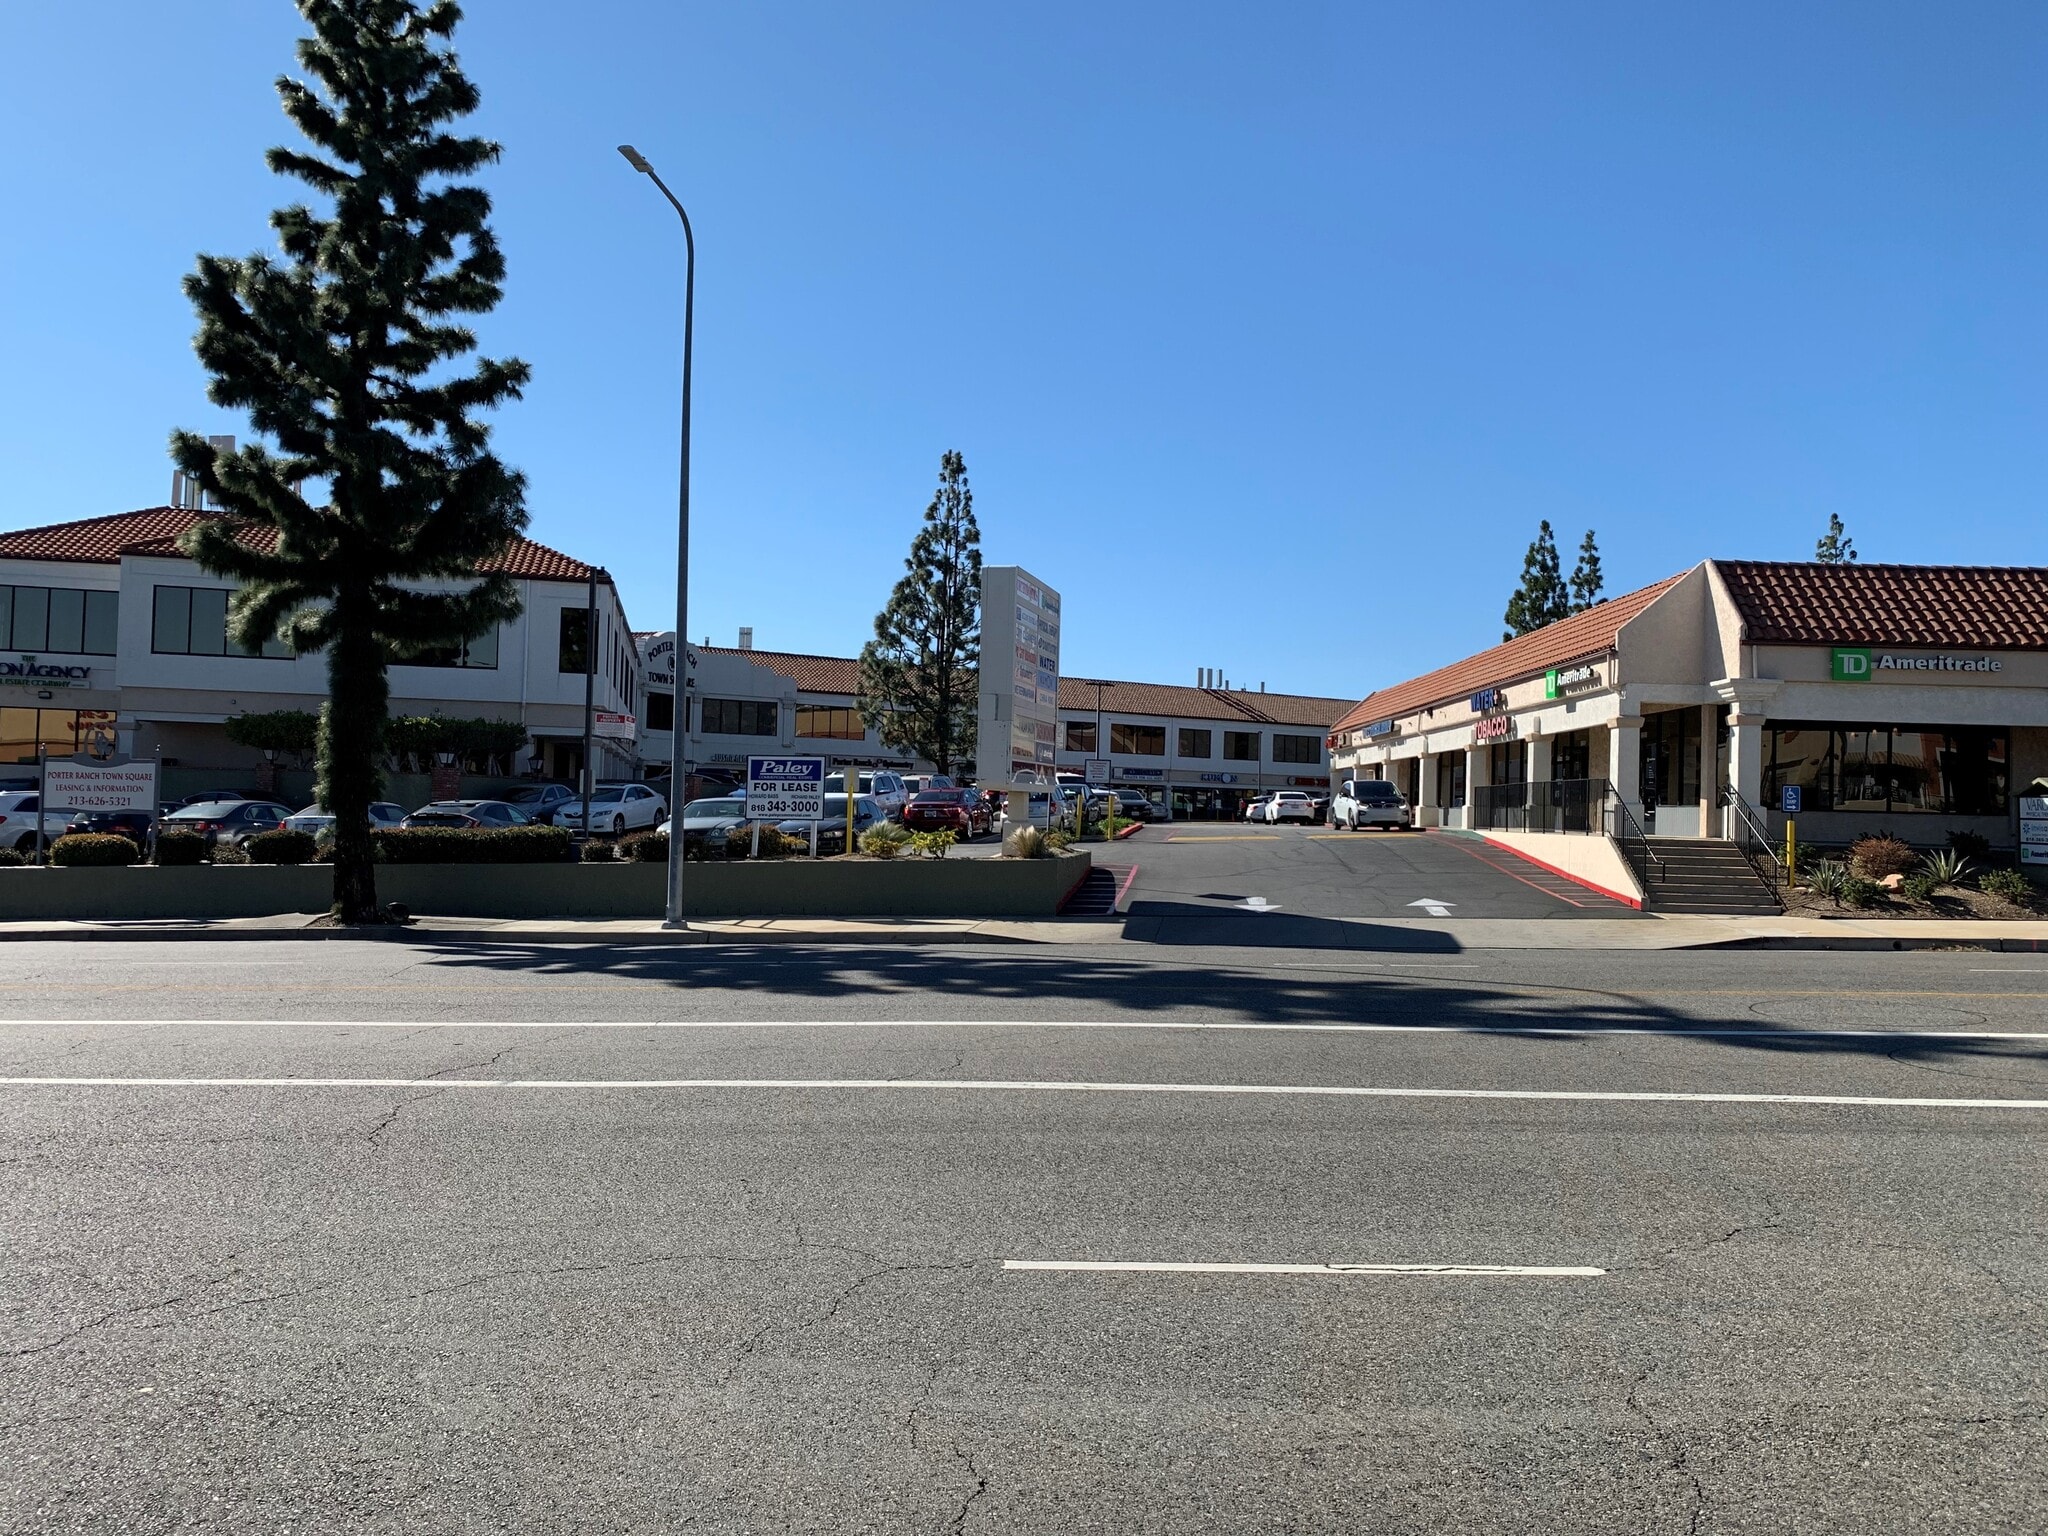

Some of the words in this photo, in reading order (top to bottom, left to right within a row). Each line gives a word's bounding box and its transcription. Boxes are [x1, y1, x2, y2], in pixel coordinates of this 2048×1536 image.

[648, 641, 674, 662] PORTER
[1040, 655, 1055, 673] WATER
[1837, 653, 1867, 674] TD
[1879, 655, 2002, 672] Ameritrade
[26, 663, 91, 678] AGENCY
[1557, 665, 1591, 686] Ameritrade
[648, 671, 668, 684] TOWN
[1474, 715, 1507, 739] TOBACCO
[760, 761, 813, 775] Paley
[832, 757, 852, 766] Porter
[853, 758, 872, 766] Ranch
[47, 771, 74, 780] PORTER
[75, 772, 100, 780] RANCH
[102, 772, 124, 780] TOWN
[125, 773, 153, 781] SQUARE
[55, 784, 85, 792] LEASING
[93, 784, 144, 792] INFORMATION
[753, 782, 777, 792] FOR
[782, 782, 818, 792] LEASE
[68, 796, 131, 806] 213-626-5321
[751, 804, 766, 812] 818
[767, 800, 819, 812] 343-3000
